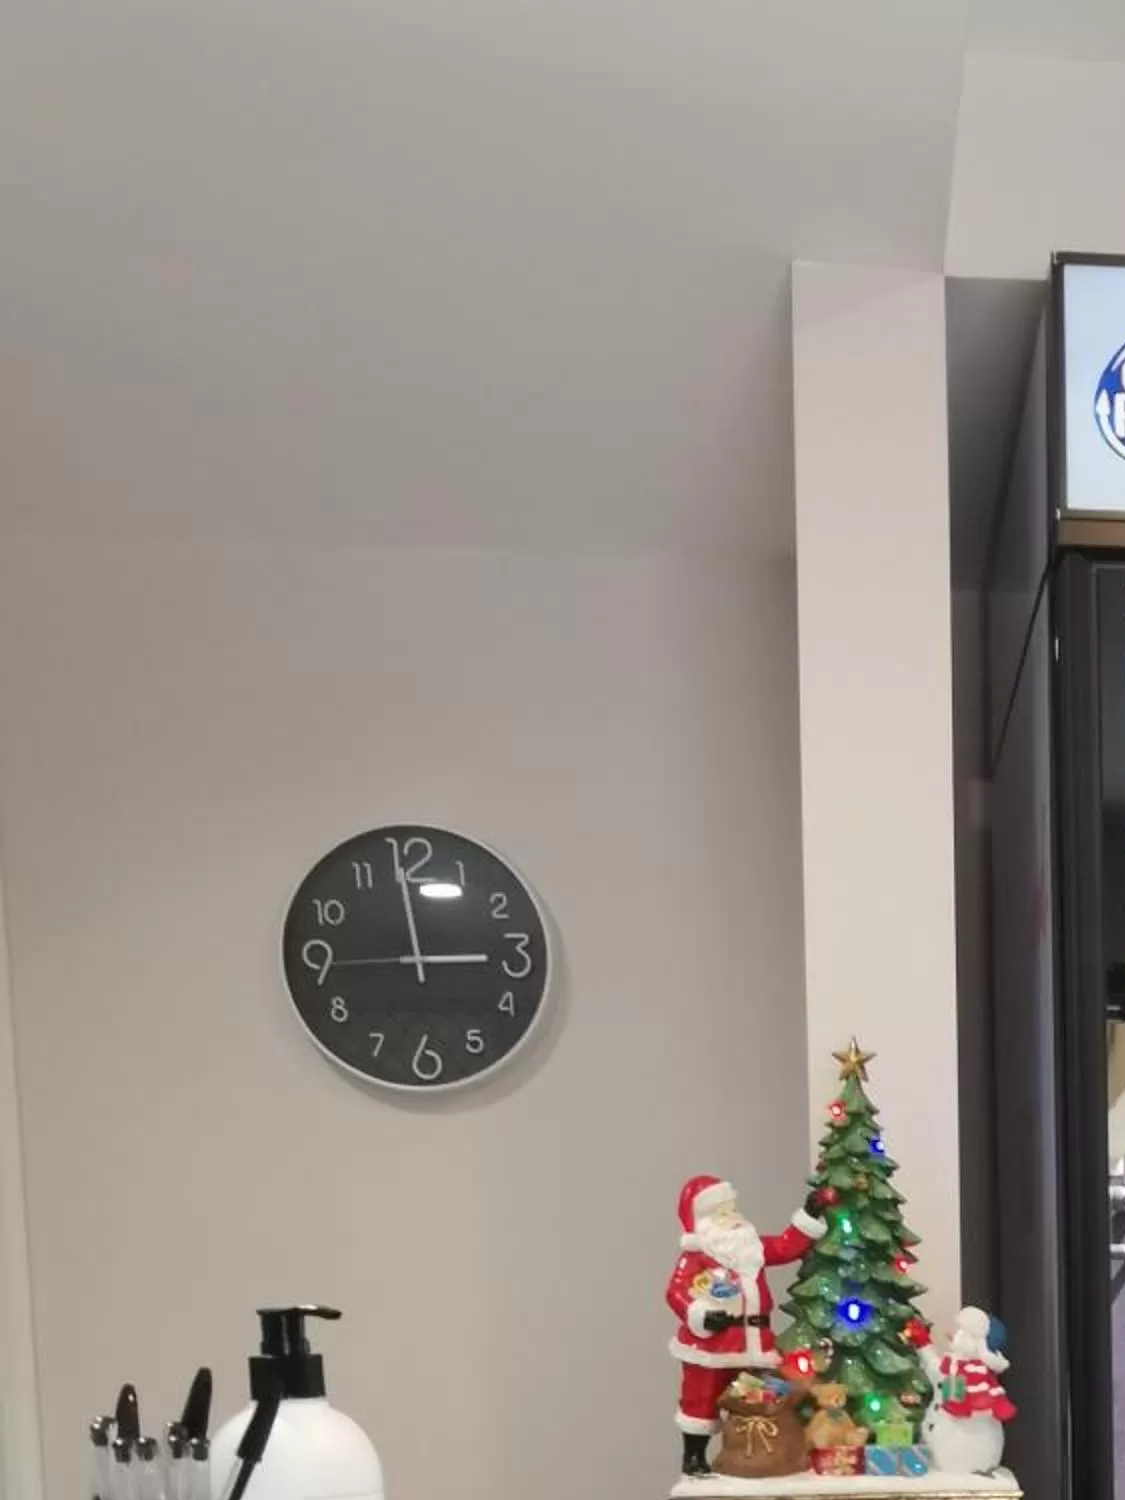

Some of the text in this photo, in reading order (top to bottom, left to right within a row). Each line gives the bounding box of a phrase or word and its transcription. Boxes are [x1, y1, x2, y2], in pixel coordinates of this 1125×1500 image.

[385, 837, 436, 884] 12
[455, 861, 465, 886] 1
[352, 862, 373, 889] 11
[312, 899, 345, 926] 10
[489, 893, 510, 919] 2
[302, 939, 333, 986] 9
[502, 933, 532, 978] 3
[330, 997, 348, 1022] 8
[497, 992, 515, 1016] 4
[369, 1033, 385, 1057] 7
[465, 1029, 484, 1053] 5
[412, 1034, 442, 1080] 6
